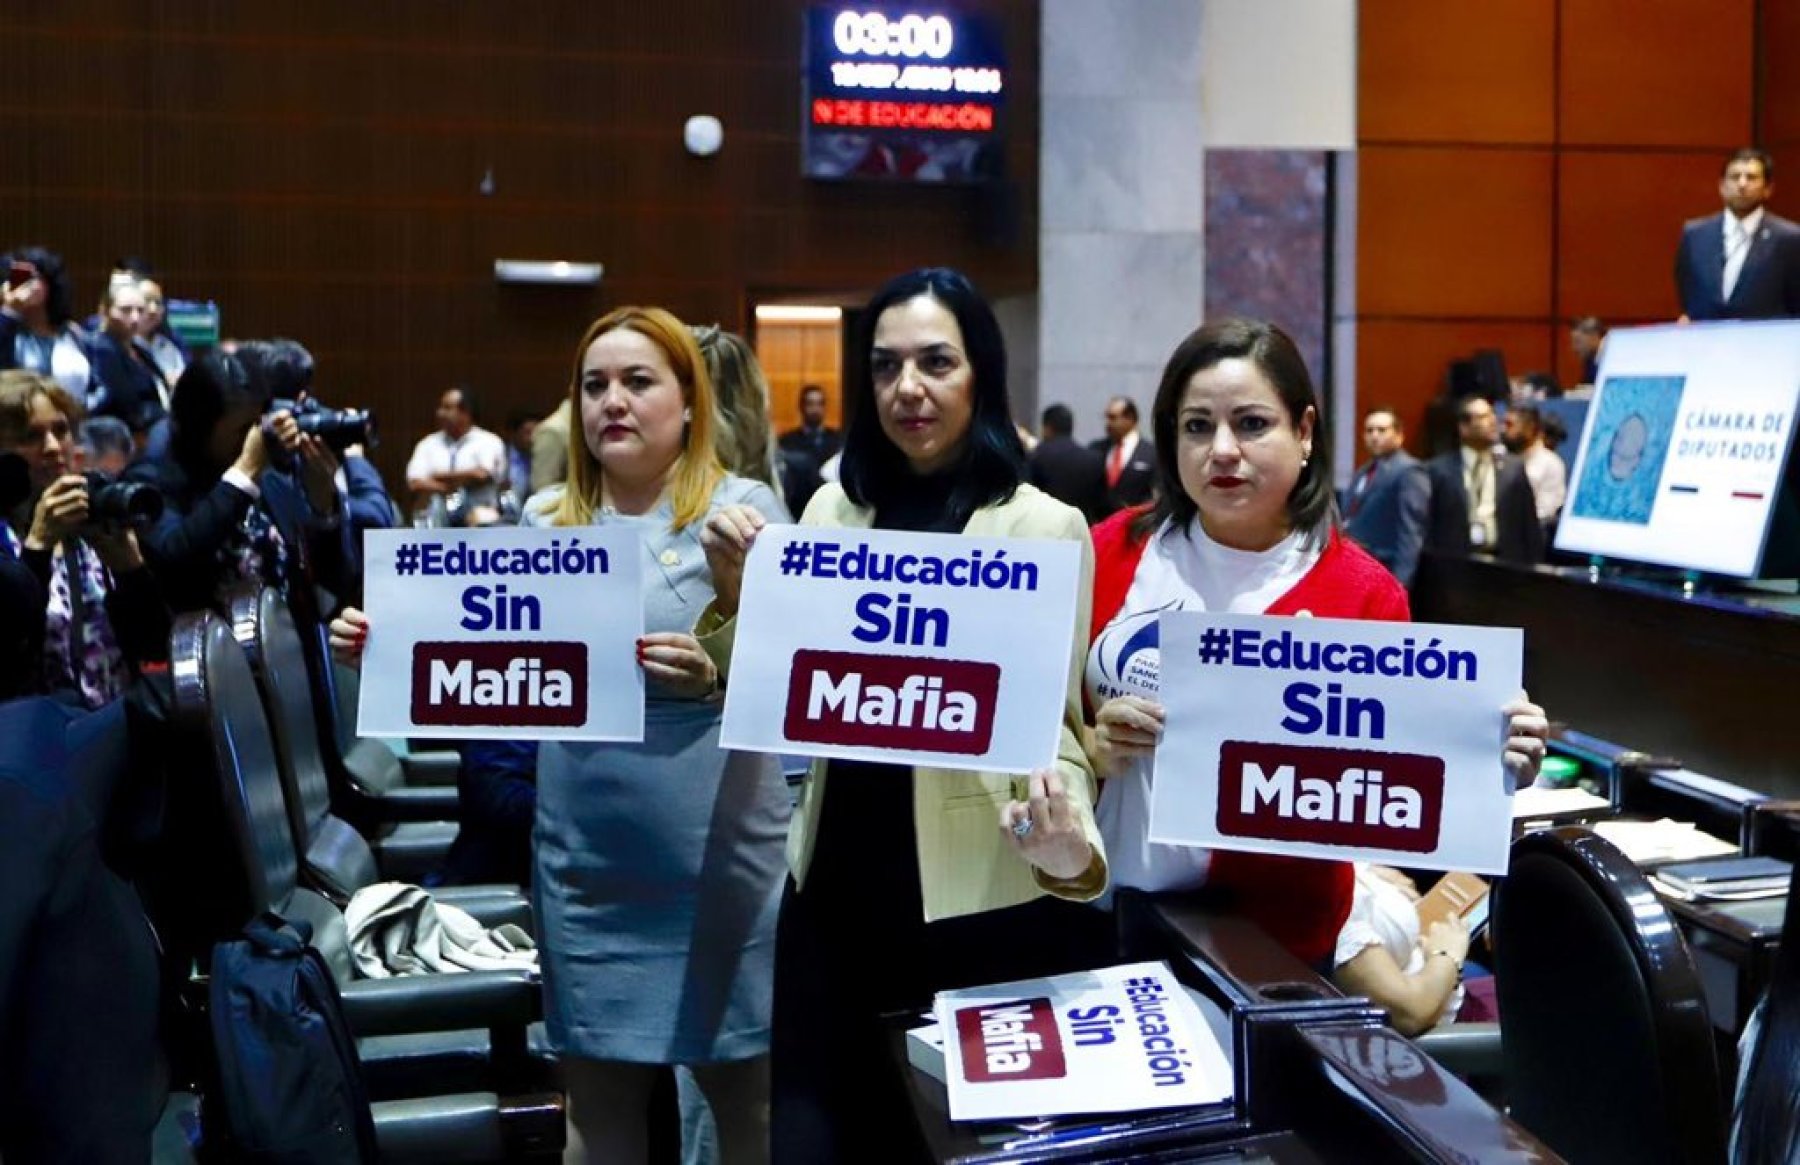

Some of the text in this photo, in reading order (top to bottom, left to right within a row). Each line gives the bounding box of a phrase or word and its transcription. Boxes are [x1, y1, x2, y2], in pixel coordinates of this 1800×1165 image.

[1762, 411, 1784, 432] DE
[1678, 439, 1776, 460] DIPUTADOS
[395, 537, 609, 576] #Educación
[780, 540, 1038, 591] #Educación
[460, 584, 541, 632] Sin
[851, 592, 950, 648] Sin
[1199, 628, 1478, 681] #Educación
[429, 658, 572, 708] Mafia
[807, 669, 977, 732] Mafia
[1280, 682, 1385, 740] Sin
[1240, 762, 1423, 829] Mafia
[979, 1004, 1043, 1075] Mafia
[1067, 1004, 1125, 1046] Sin
[1124, 976, 1192, 1087] #Educación
